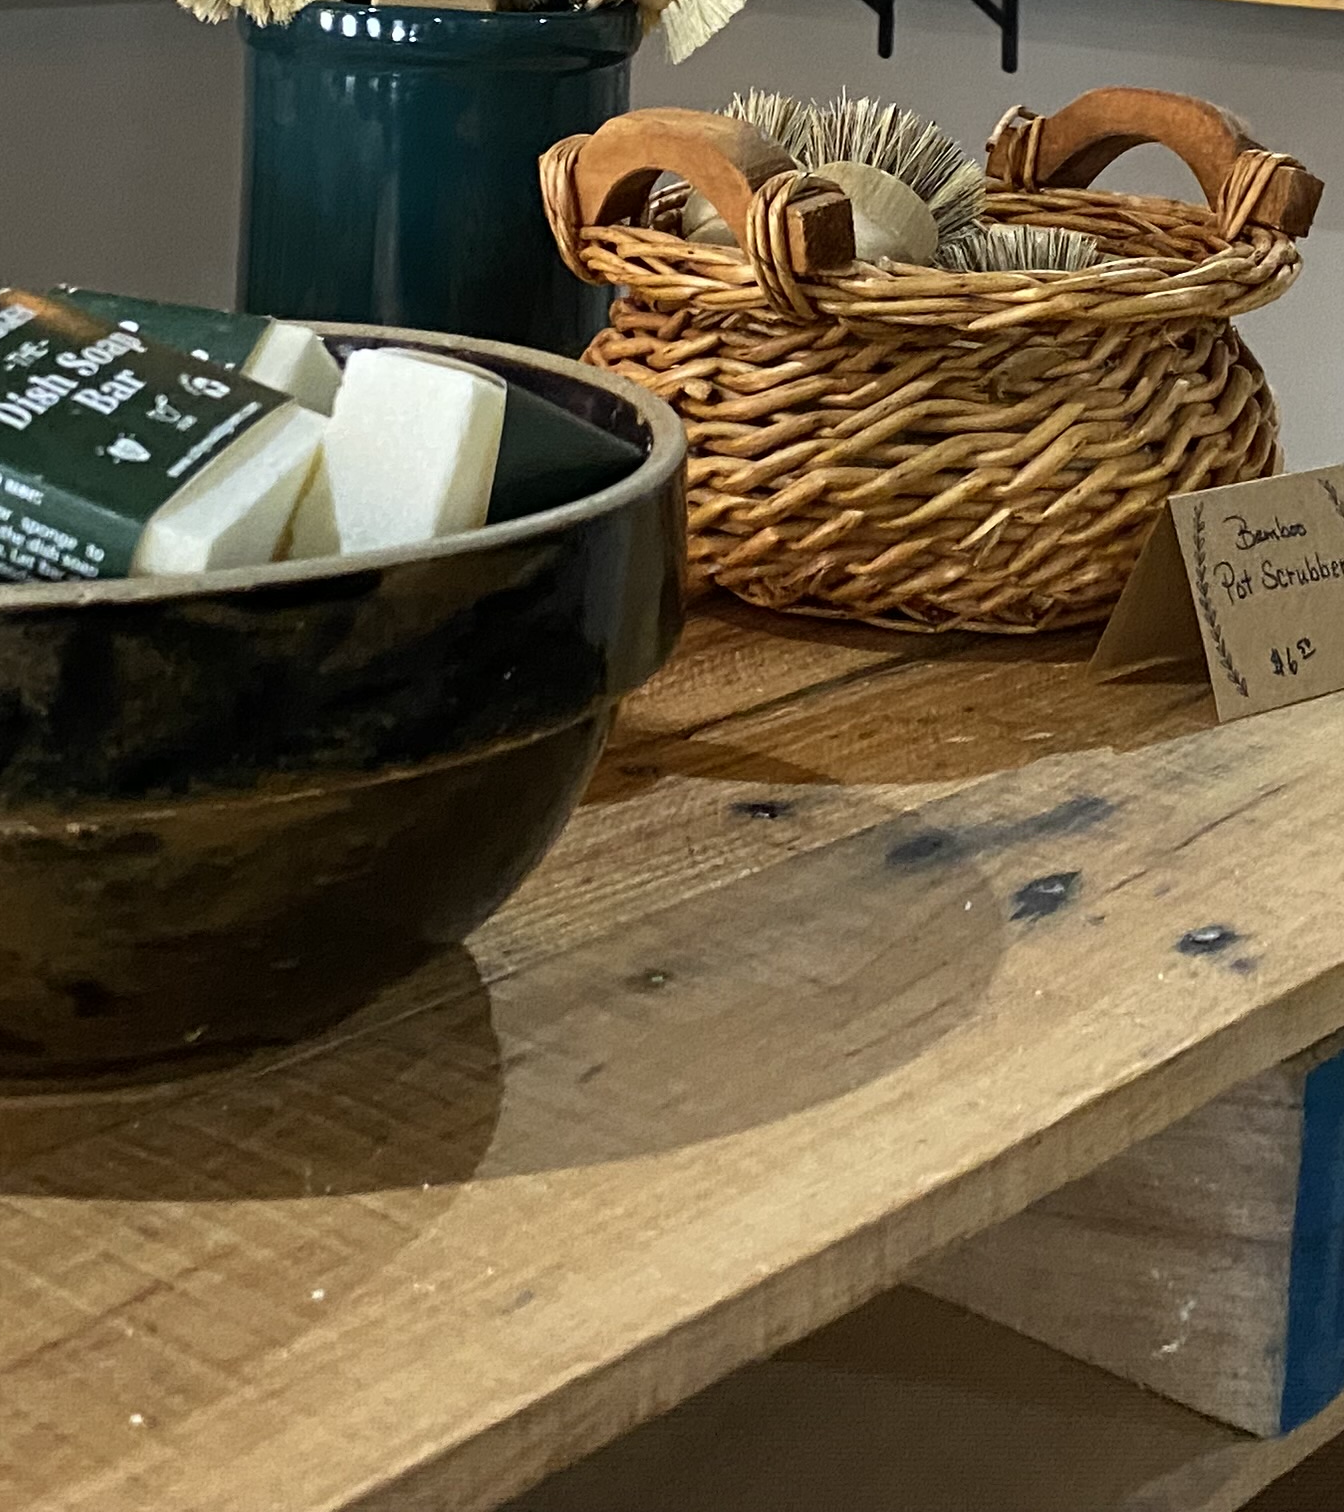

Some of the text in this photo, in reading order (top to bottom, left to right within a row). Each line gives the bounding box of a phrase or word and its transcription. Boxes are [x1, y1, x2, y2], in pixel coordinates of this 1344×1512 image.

[55, 331, 148, 377] Soap
[71, 368, 148, 416] Bar
[1222, 514, 1307, 551] Bamboo
[1213, 560, 1254, 606] Pot
